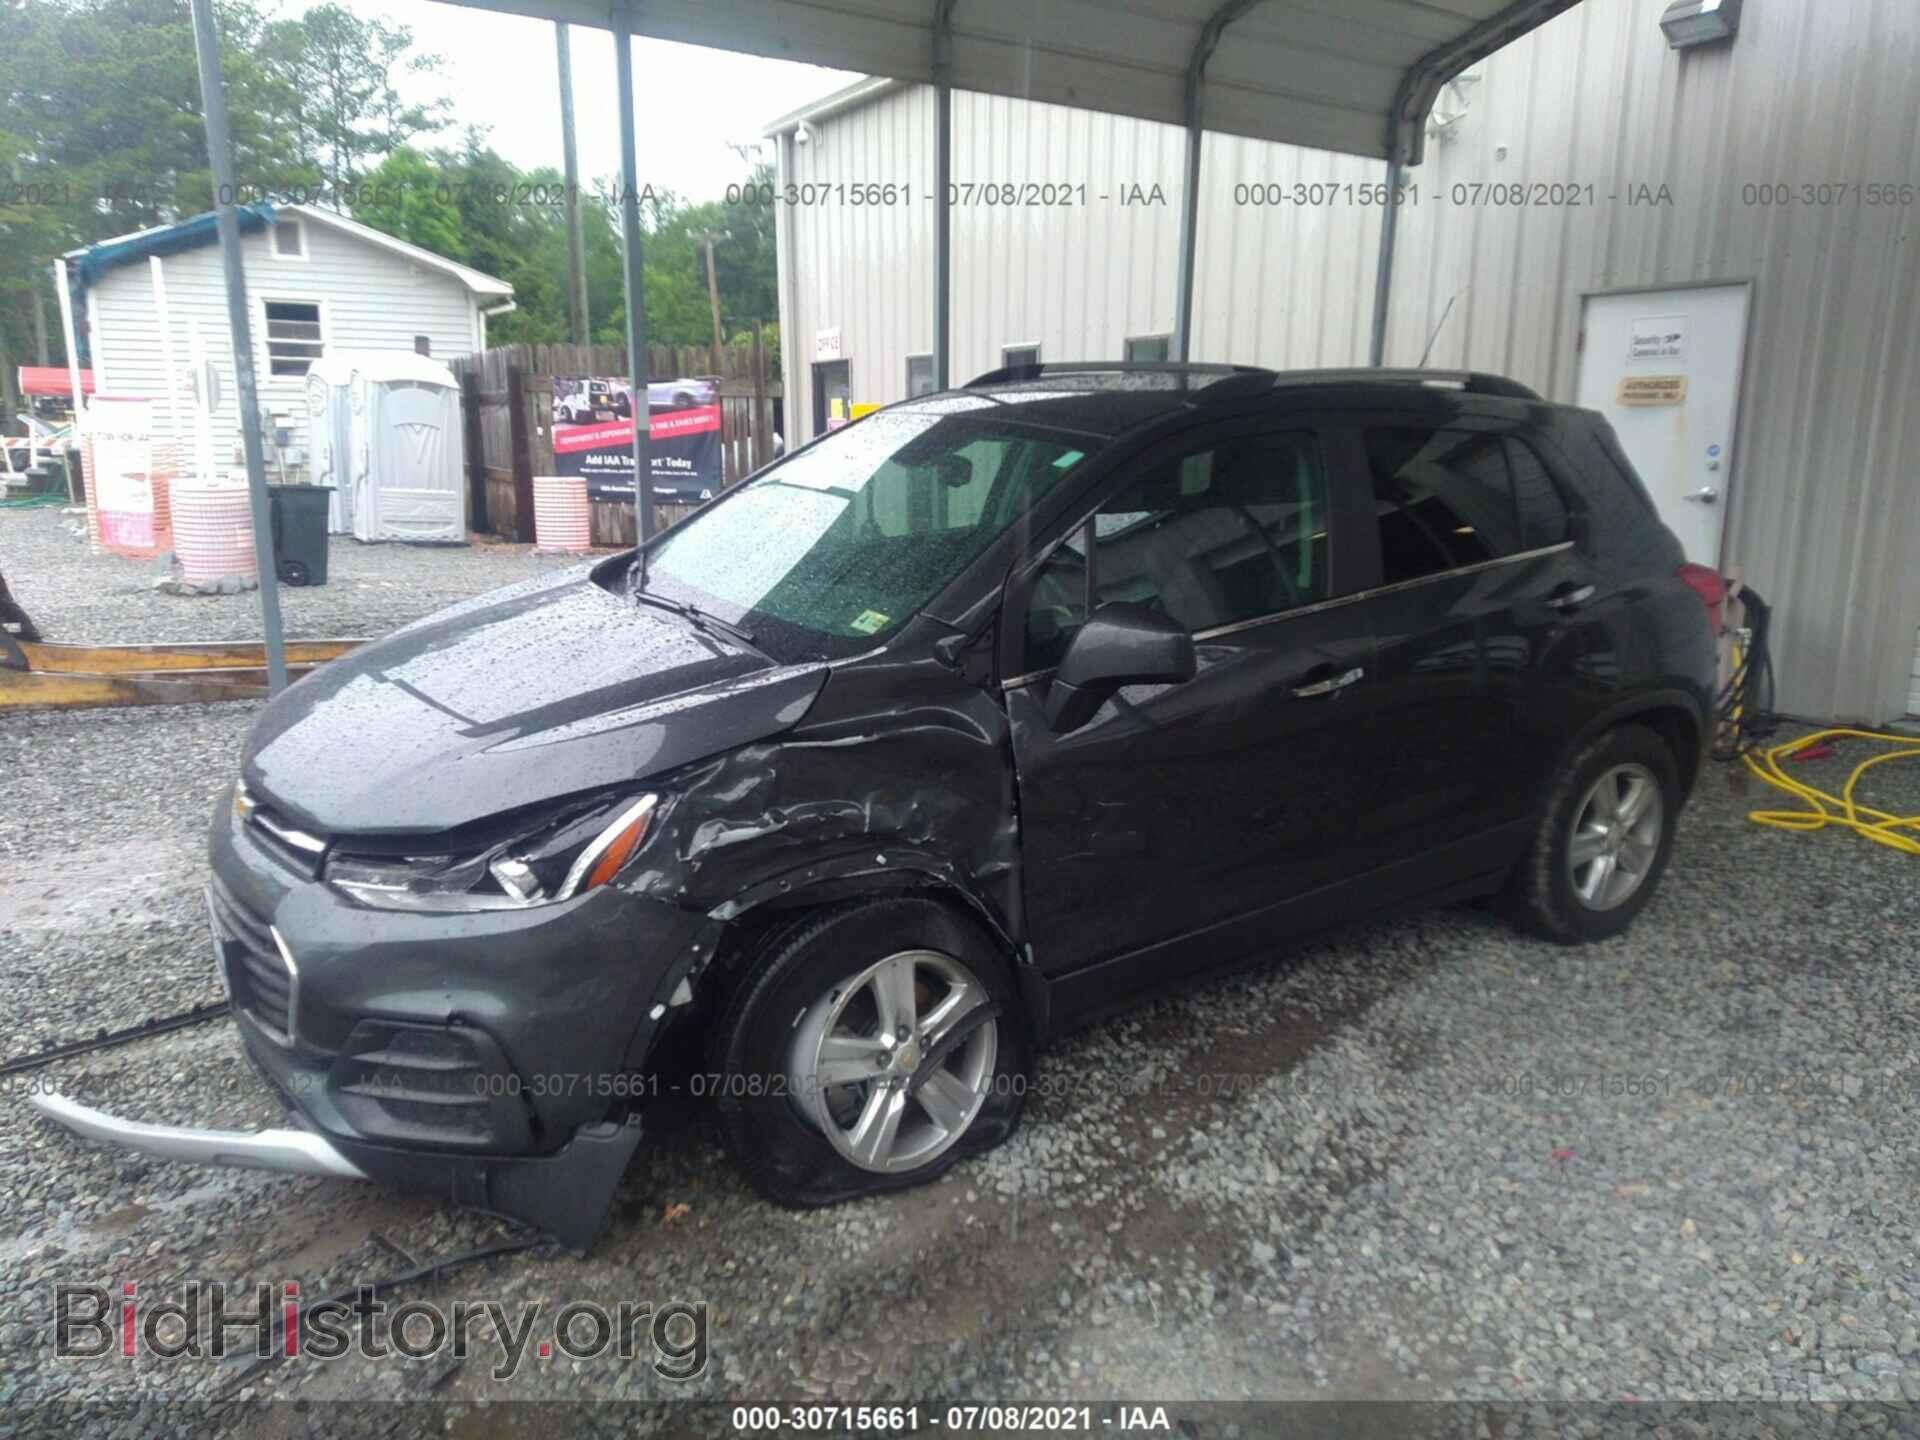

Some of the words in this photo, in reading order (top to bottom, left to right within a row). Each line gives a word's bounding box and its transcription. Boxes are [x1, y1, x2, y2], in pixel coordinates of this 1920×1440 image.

[585, 454, 601, 465] Add
[604, 455, 621, 466] IAA
[666, 456, 692, 469] Today
